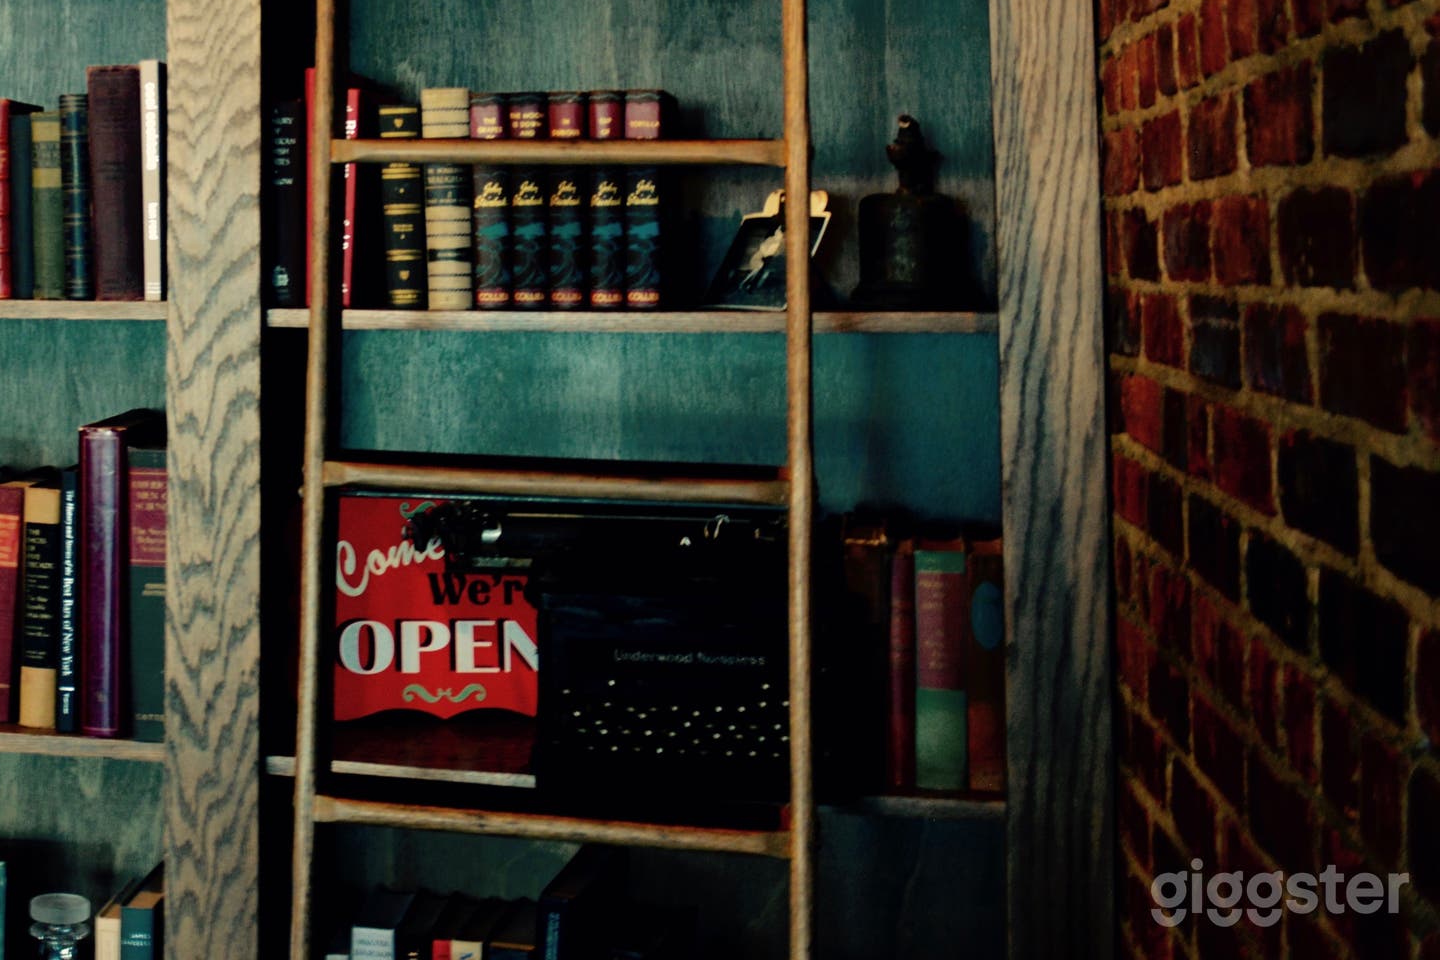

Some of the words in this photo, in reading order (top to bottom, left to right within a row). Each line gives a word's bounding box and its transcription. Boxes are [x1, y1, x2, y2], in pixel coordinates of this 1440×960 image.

[477, 126, 503, 134] GRAPES
[336, 535, 447, 597] Come
[63, 577, 74, 596] Best
[62, 599, 73, 618] Bars
[62, 632, 73, 653] New
[338, 619, 540, 674] OPEN
[61, 655, 72, 676] York
[613, 648, 693, 664] Underwood
